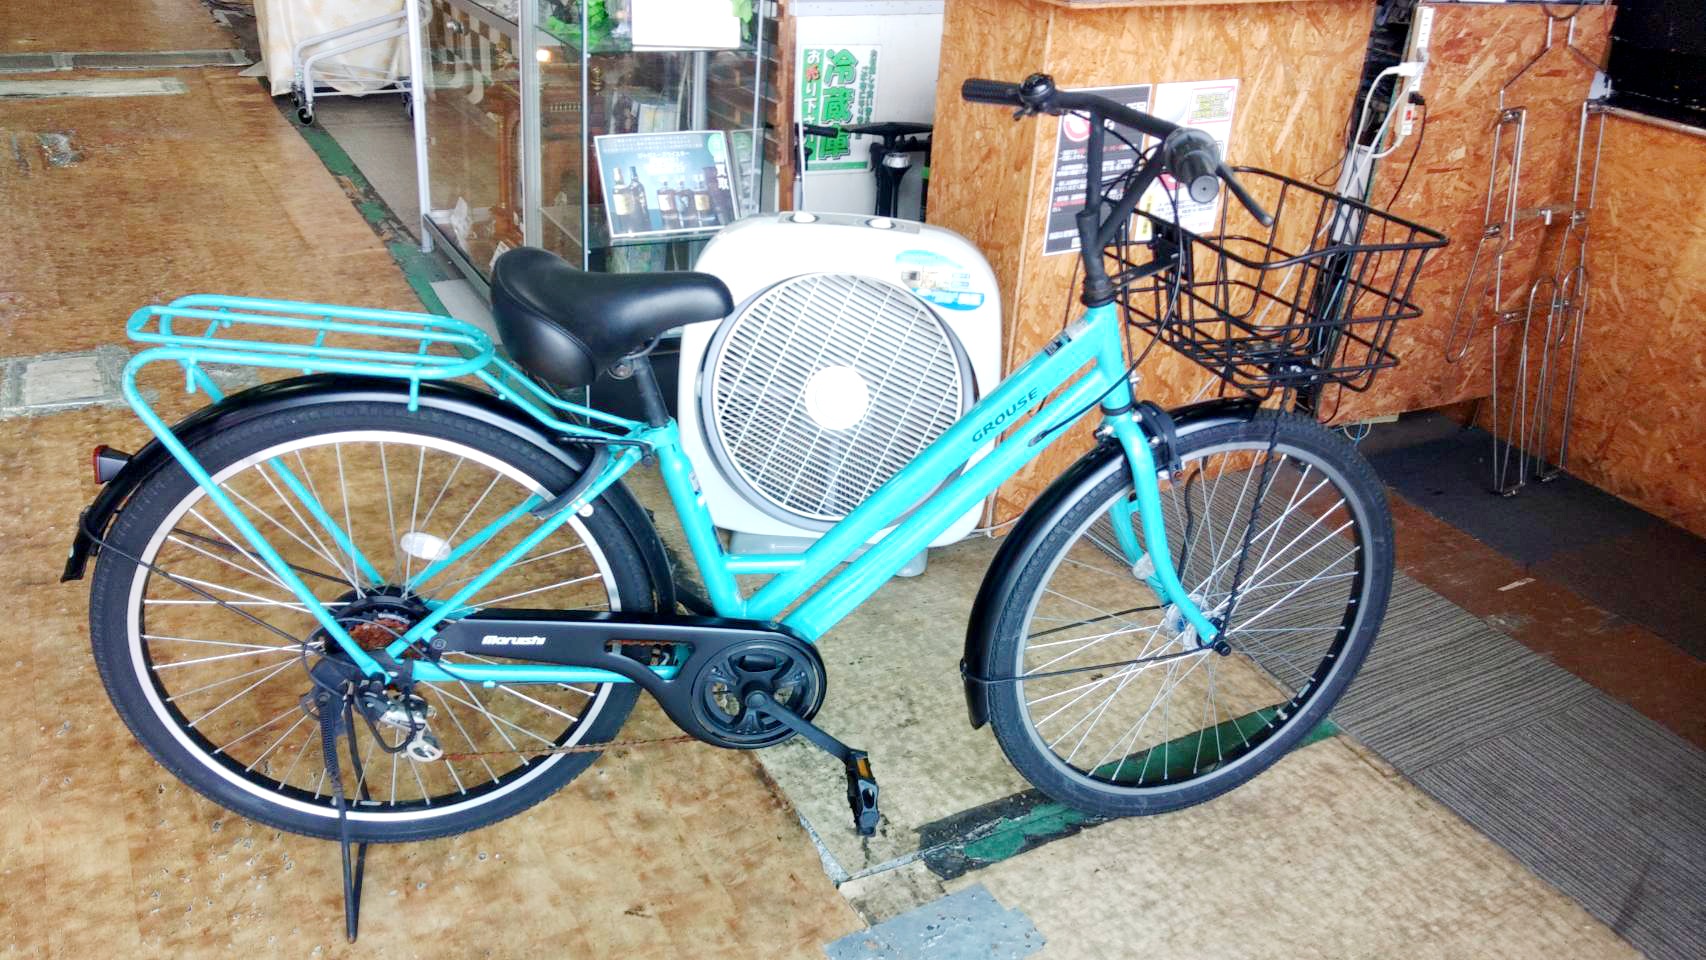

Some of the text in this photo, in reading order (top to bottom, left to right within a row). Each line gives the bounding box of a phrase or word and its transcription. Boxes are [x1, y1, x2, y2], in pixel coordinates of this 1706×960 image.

[818, 48, 859, 160] 冷蔵庫
[972, 387, 1038, 442] GROUSE
[481, 635, 547, 645] Maruishi
